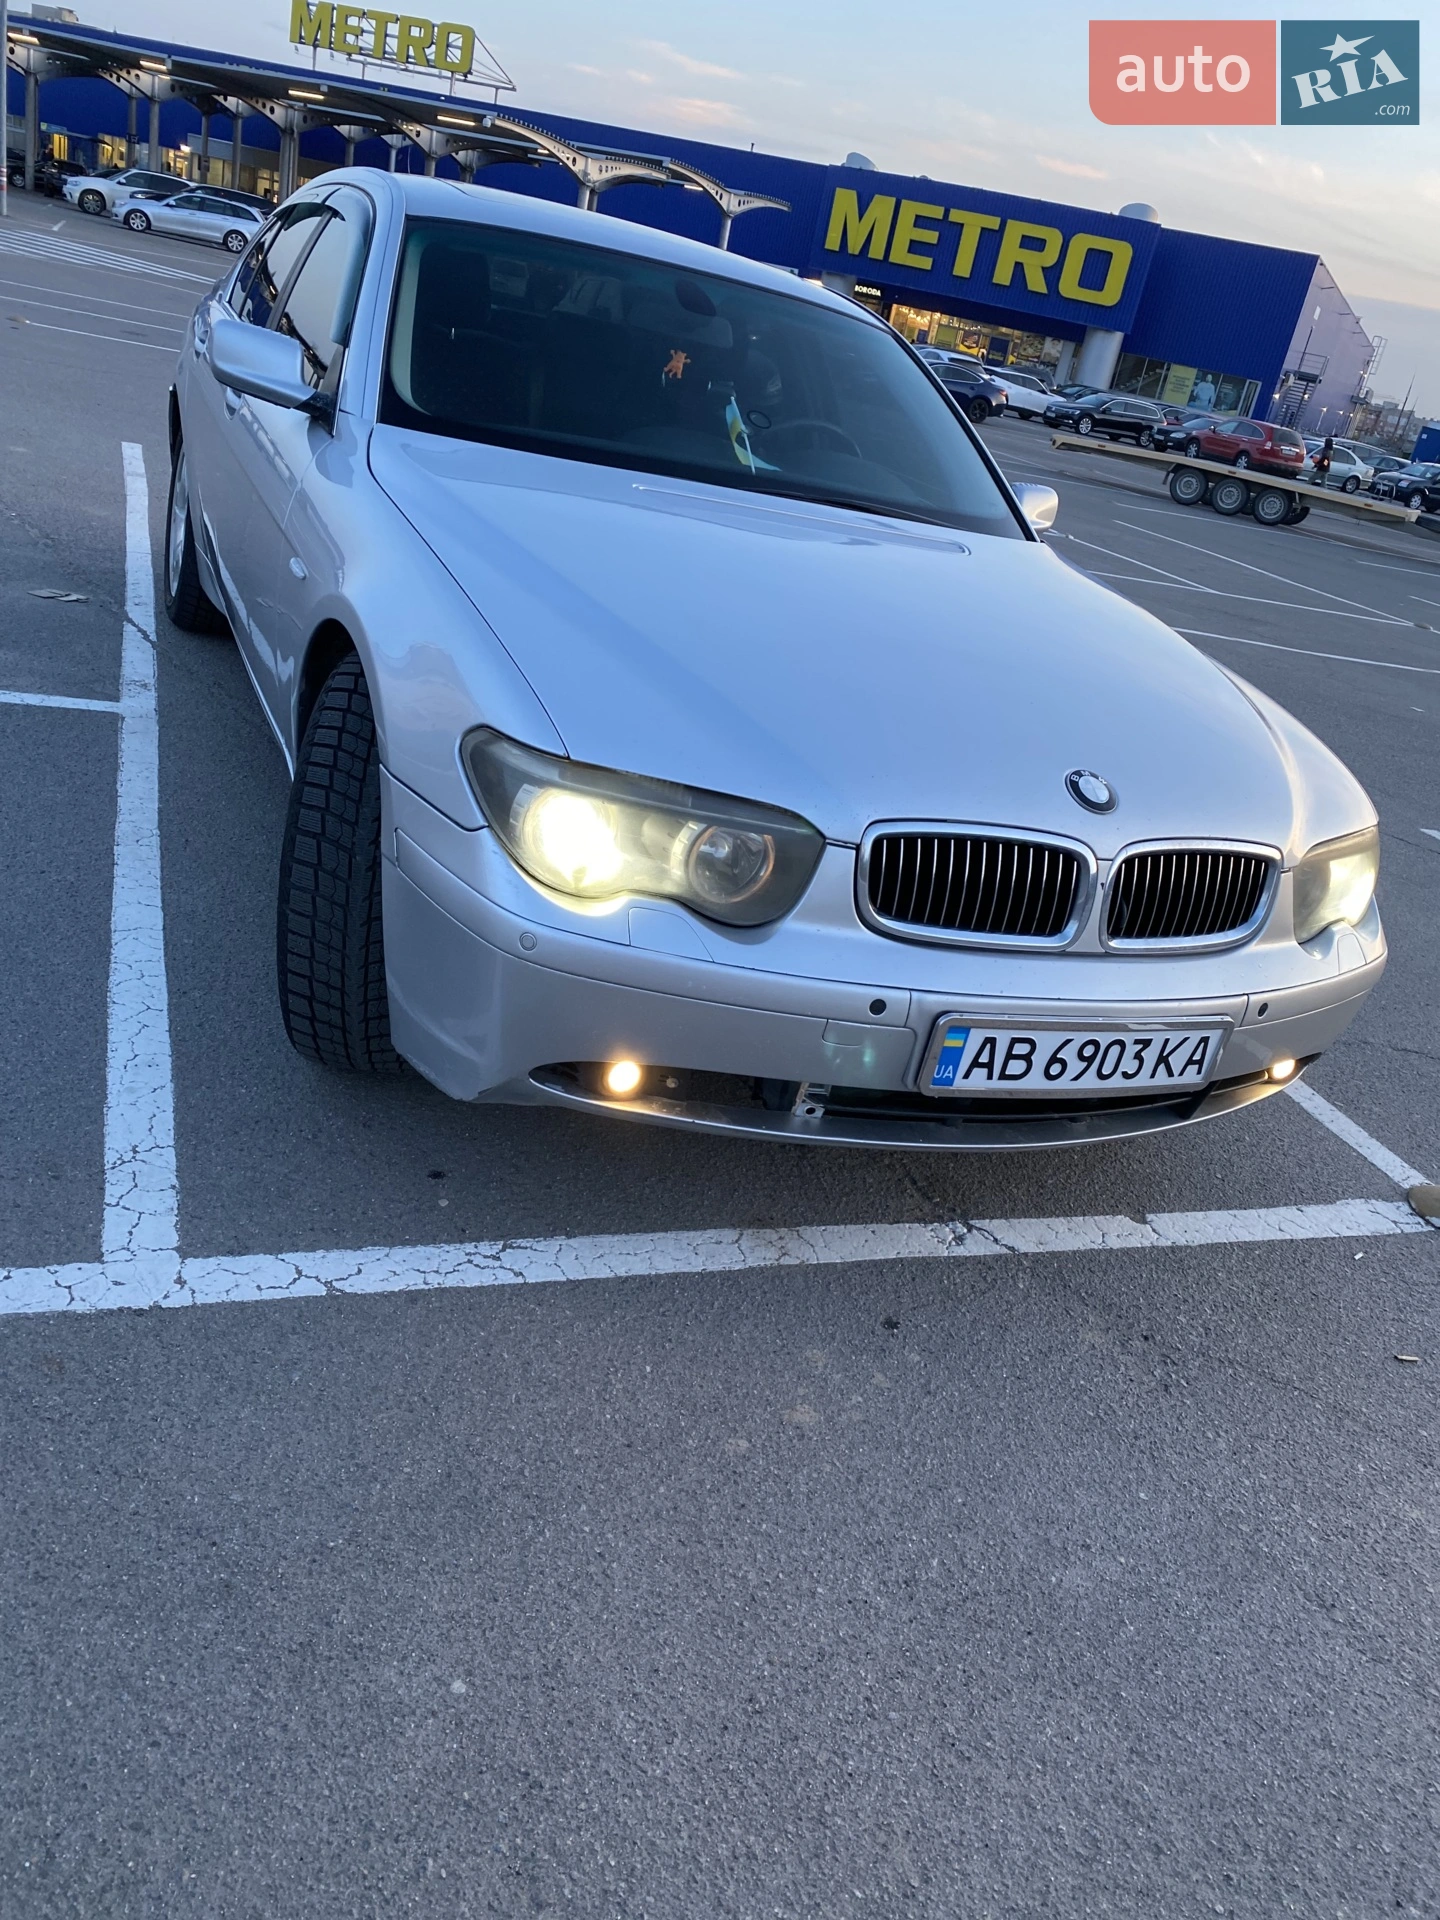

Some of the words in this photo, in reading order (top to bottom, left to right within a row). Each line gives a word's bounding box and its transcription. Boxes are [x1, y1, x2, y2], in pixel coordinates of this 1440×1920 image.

[289, 0, 476, 74] METRO
[824, 187, 1133, 307] METRO
[933, 1064, 954, 1079] UA
